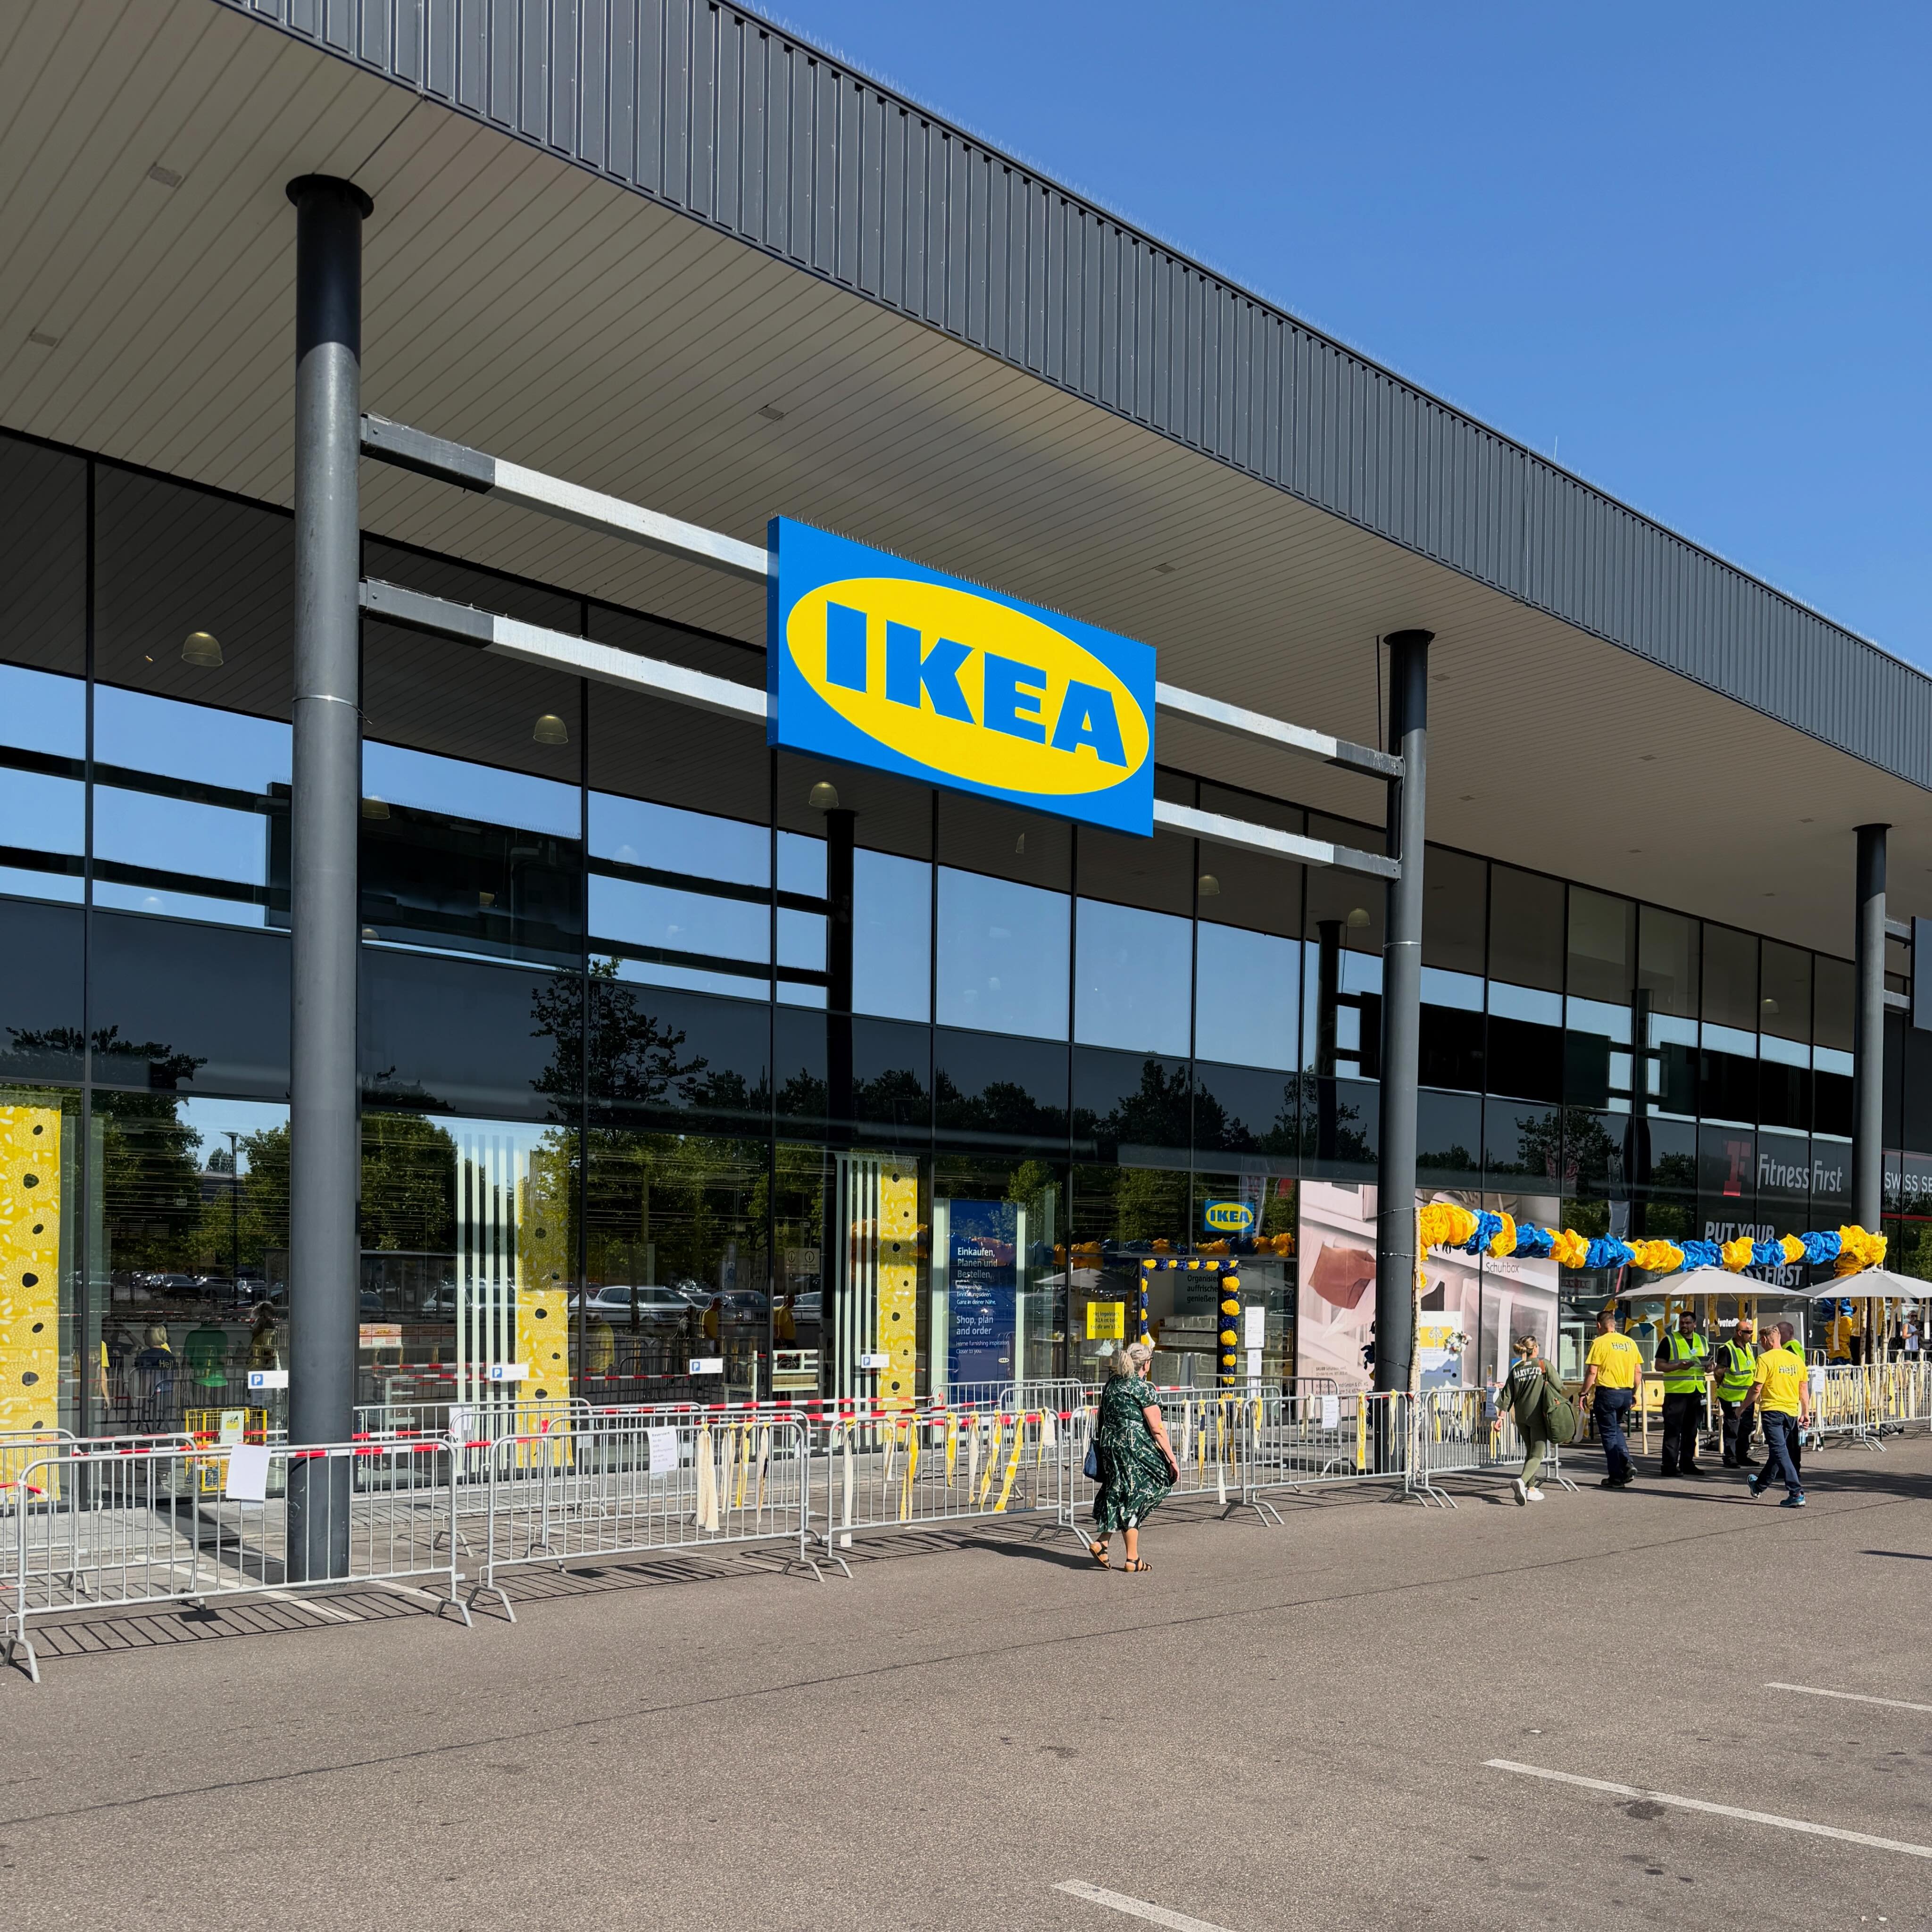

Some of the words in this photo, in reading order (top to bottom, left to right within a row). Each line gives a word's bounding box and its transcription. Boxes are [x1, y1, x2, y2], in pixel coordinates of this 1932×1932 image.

[827, 600, 1128, 768] IKEA
[1758, 1153, 1809, 1189] Fitness
[1812, 1160, 1842, 1194] First
[1885, 1172, 1918, 1192] SWSS
[1210, 1210, 1250, 1223] IKEA
[1704, 1222, 1735, 1244] PUT
[958, 1247, 995, 1257] Einkaufen,
[958, 1258, 981, 1267] Planen
[984, 1258, 998, 1267] und
[1486, 1261, 1519, 1273] Schuhbox
[1764, 1265, 1803, 1286] FIRST
[1187, 1294, 1216, 1304] genießen
[957, 1315, 976, 1326] Shop,
[978, 1315, 993, 1326] plan
[957, 1326, 970, 1335] and
[972, 1326, 991, 1335] order
